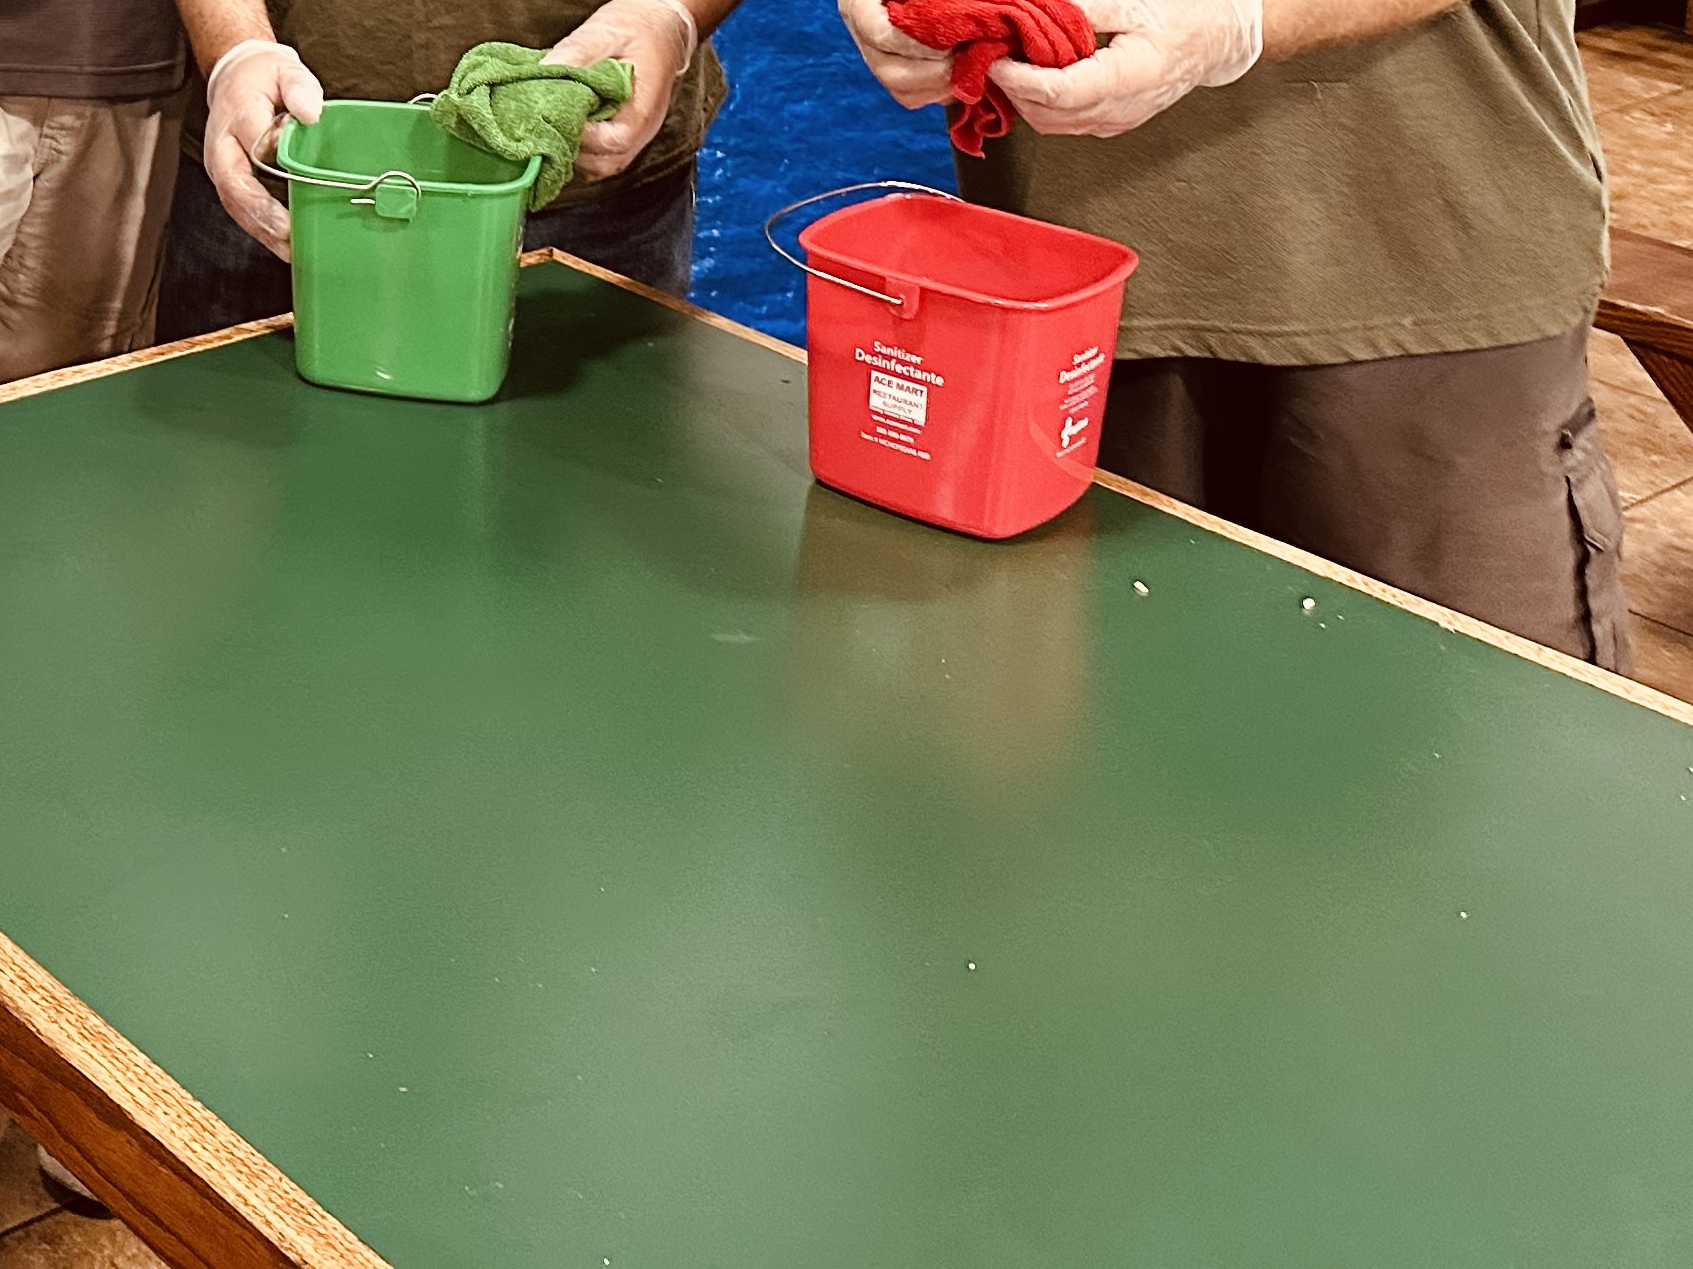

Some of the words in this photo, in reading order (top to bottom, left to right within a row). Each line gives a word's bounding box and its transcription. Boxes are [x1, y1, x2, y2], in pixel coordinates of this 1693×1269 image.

[873, 340, 924, 365] Sanitizer
[855, 347, 945, 387] Desinfectante
[873, 375, 894, 389] ACE
[896, 382, 924, 398] MART
